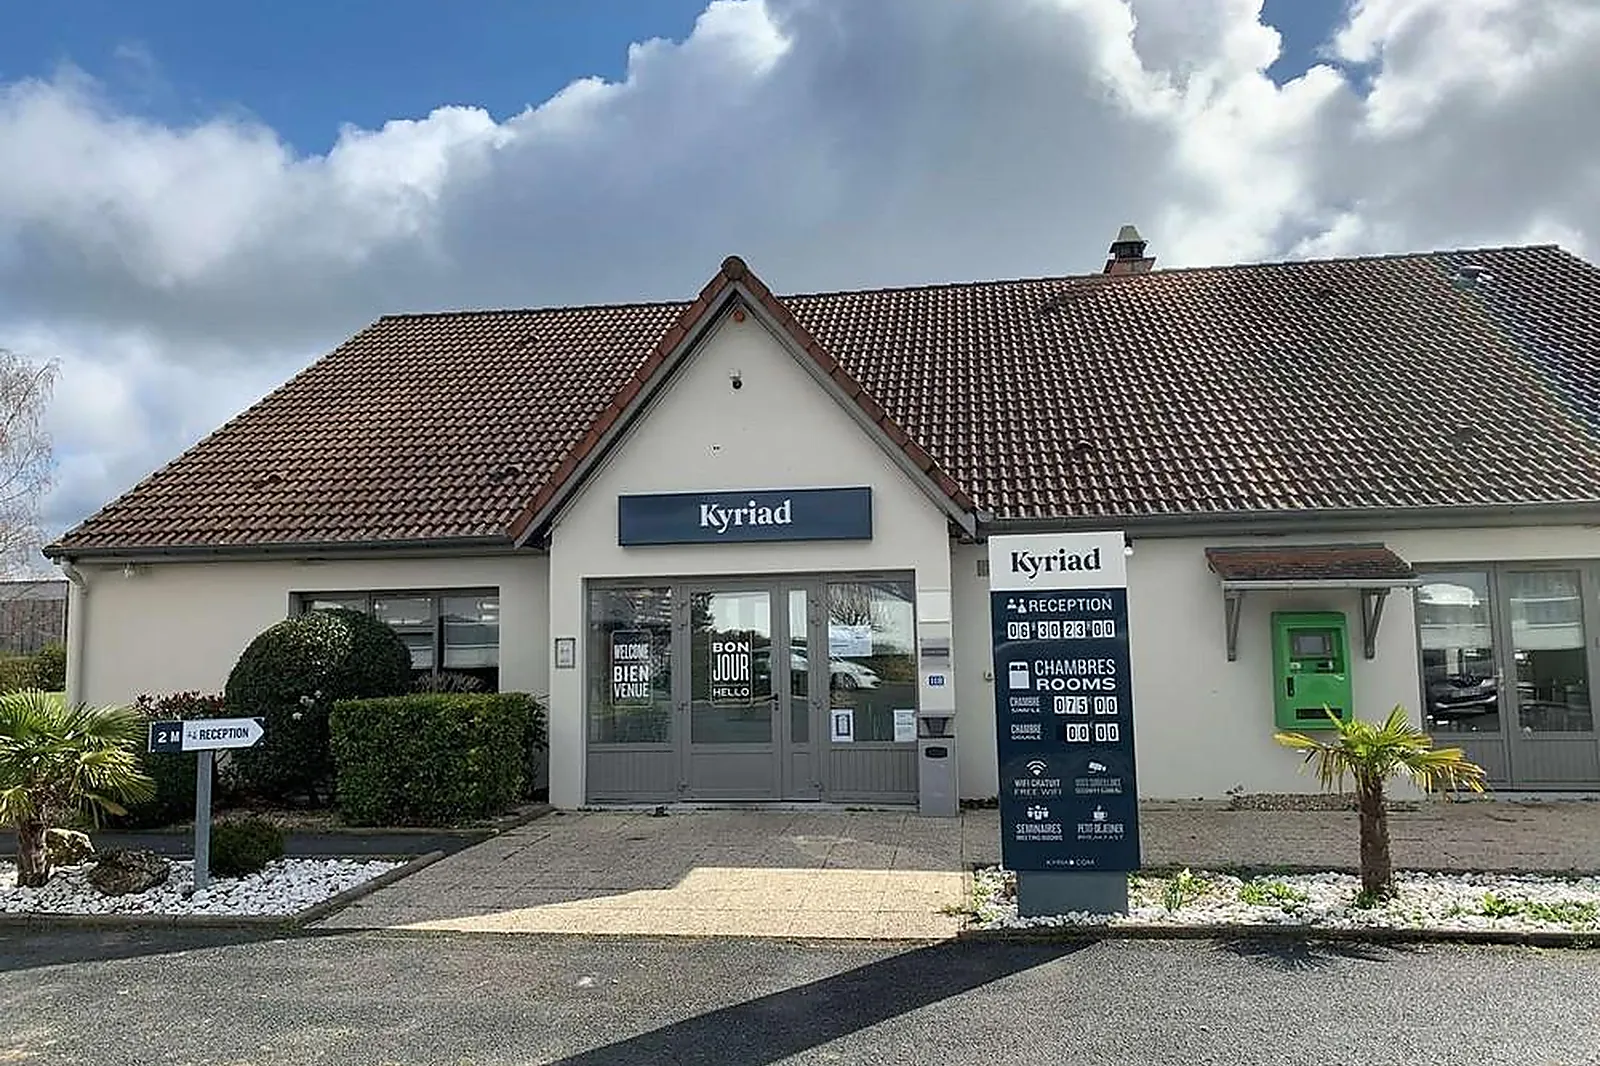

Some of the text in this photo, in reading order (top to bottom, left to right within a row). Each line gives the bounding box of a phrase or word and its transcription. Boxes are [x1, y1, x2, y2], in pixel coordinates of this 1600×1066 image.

[700, 500, 792, 533] Kyriad
[1011, 548, 1102, 579] Kyriad
[1028, 598, 1112, 613] RECEPTION
[1008, 620, 1115, 639] 06 30 23 00
[613, 644, 649, 660] WELCOME
[713, 642, 749, 653] BON
[613, 665, 649, 682] BIEN
[713, 653, 749, 681] JOUR
[1034, 659, 1116, 676] CHAMBRES
[613, 683, 649, 698] VENUE
[713, 687, 749, 697] HELLO
[1036, 678, 1116, 690] ROOMS
[158, 727, 249, 743] 2 M RECEPTION
